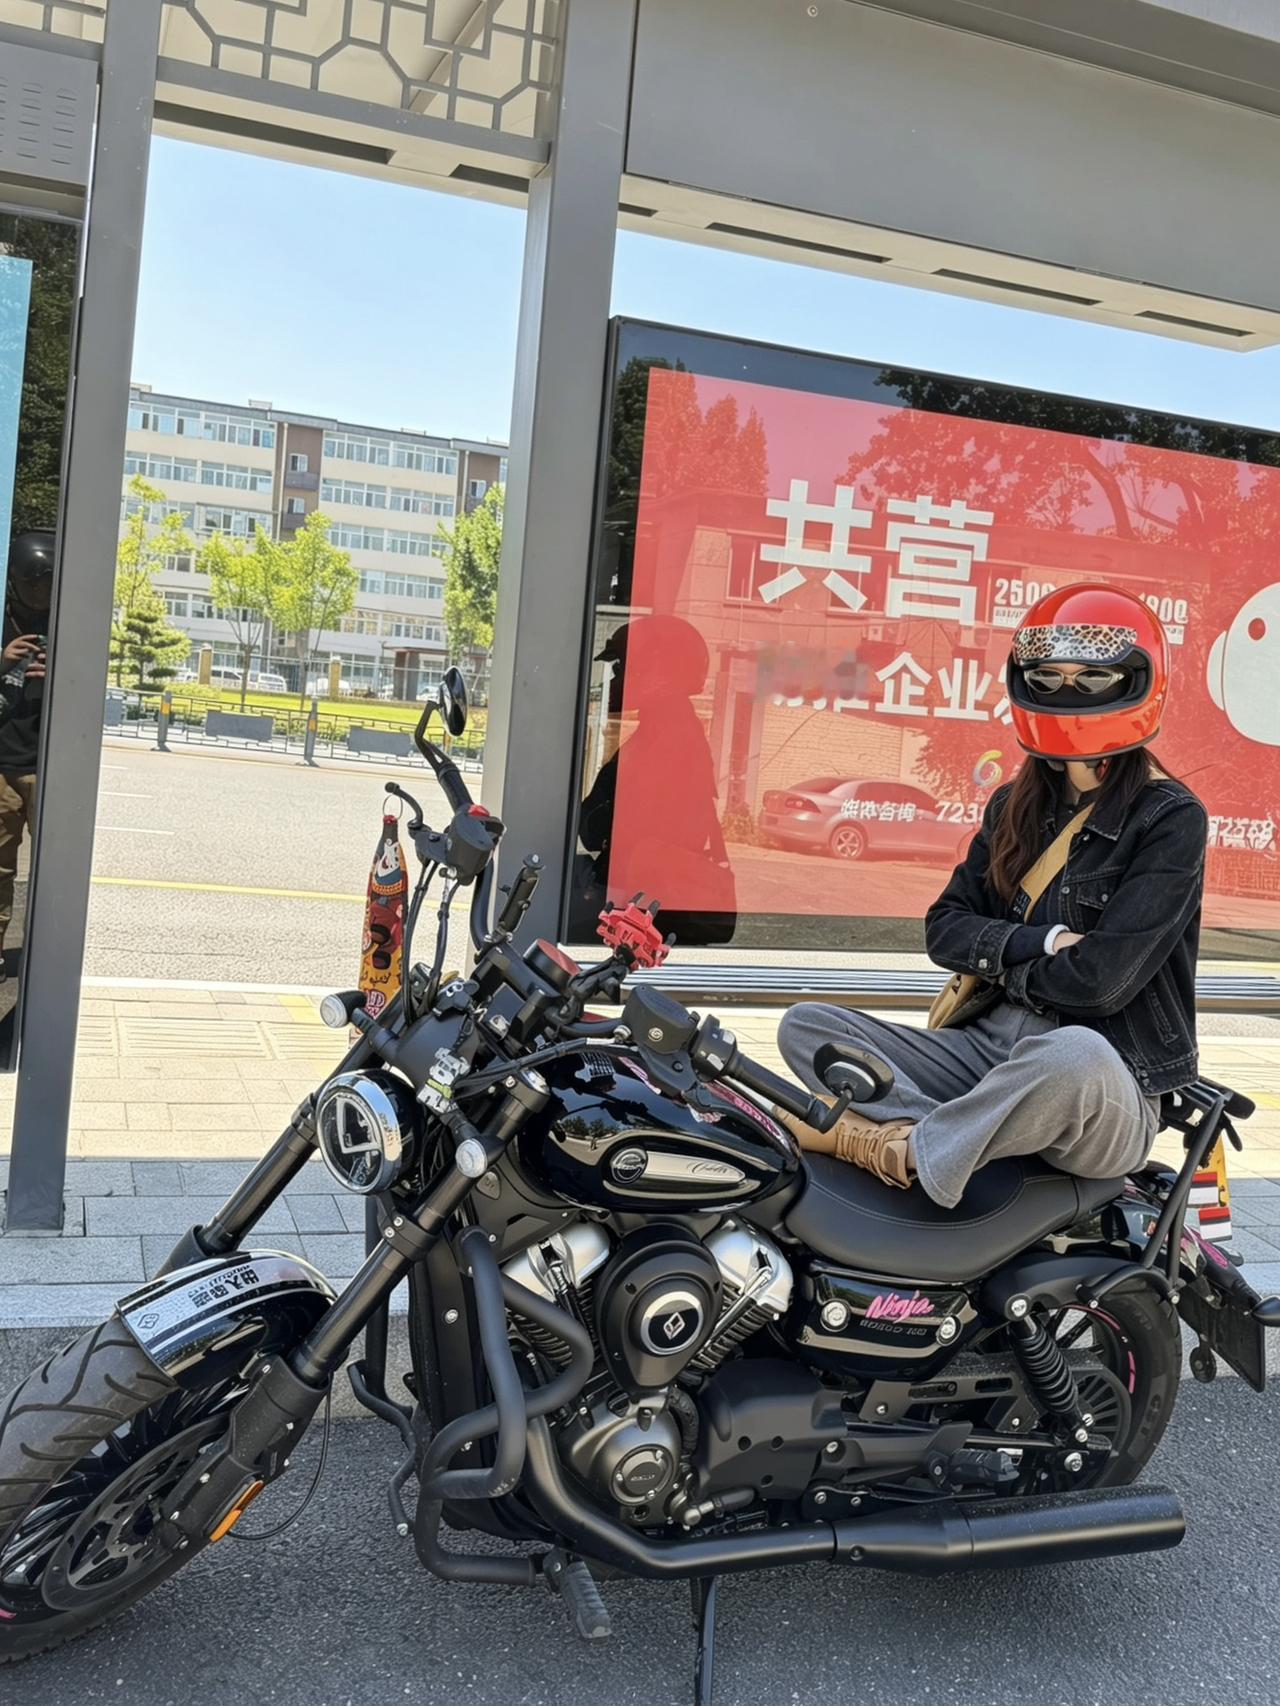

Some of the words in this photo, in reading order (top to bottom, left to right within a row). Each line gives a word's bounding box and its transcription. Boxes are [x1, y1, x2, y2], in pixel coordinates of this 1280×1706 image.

[758, 479, 994, 626] 共营
[935, 801, 984, 825] 723
[865, 1289, 935, 1324] Ninja
